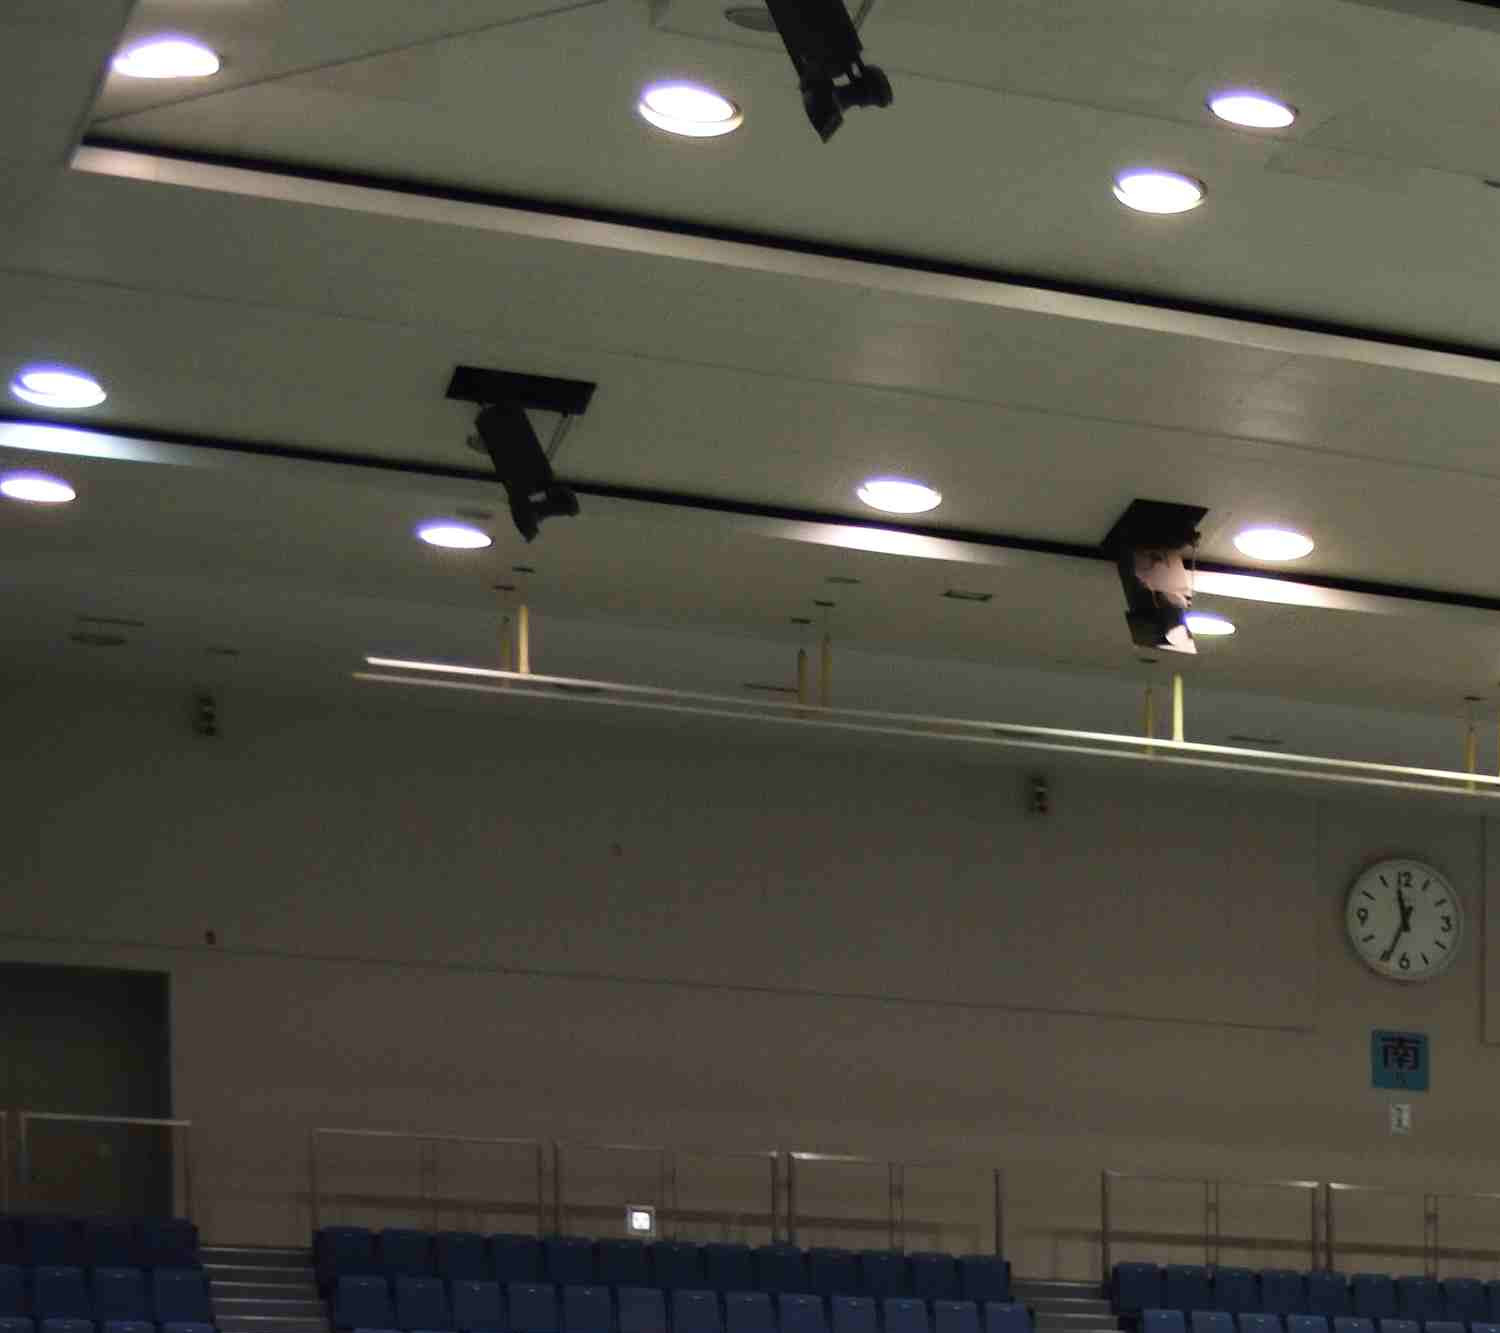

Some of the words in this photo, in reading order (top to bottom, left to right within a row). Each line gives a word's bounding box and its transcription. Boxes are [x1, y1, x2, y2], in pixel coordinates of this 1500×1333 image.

[1356, 907, 1369, 926] 9
[1440, 915, 1452, 932] 3
[1399, 952, 1410, 970] 6
